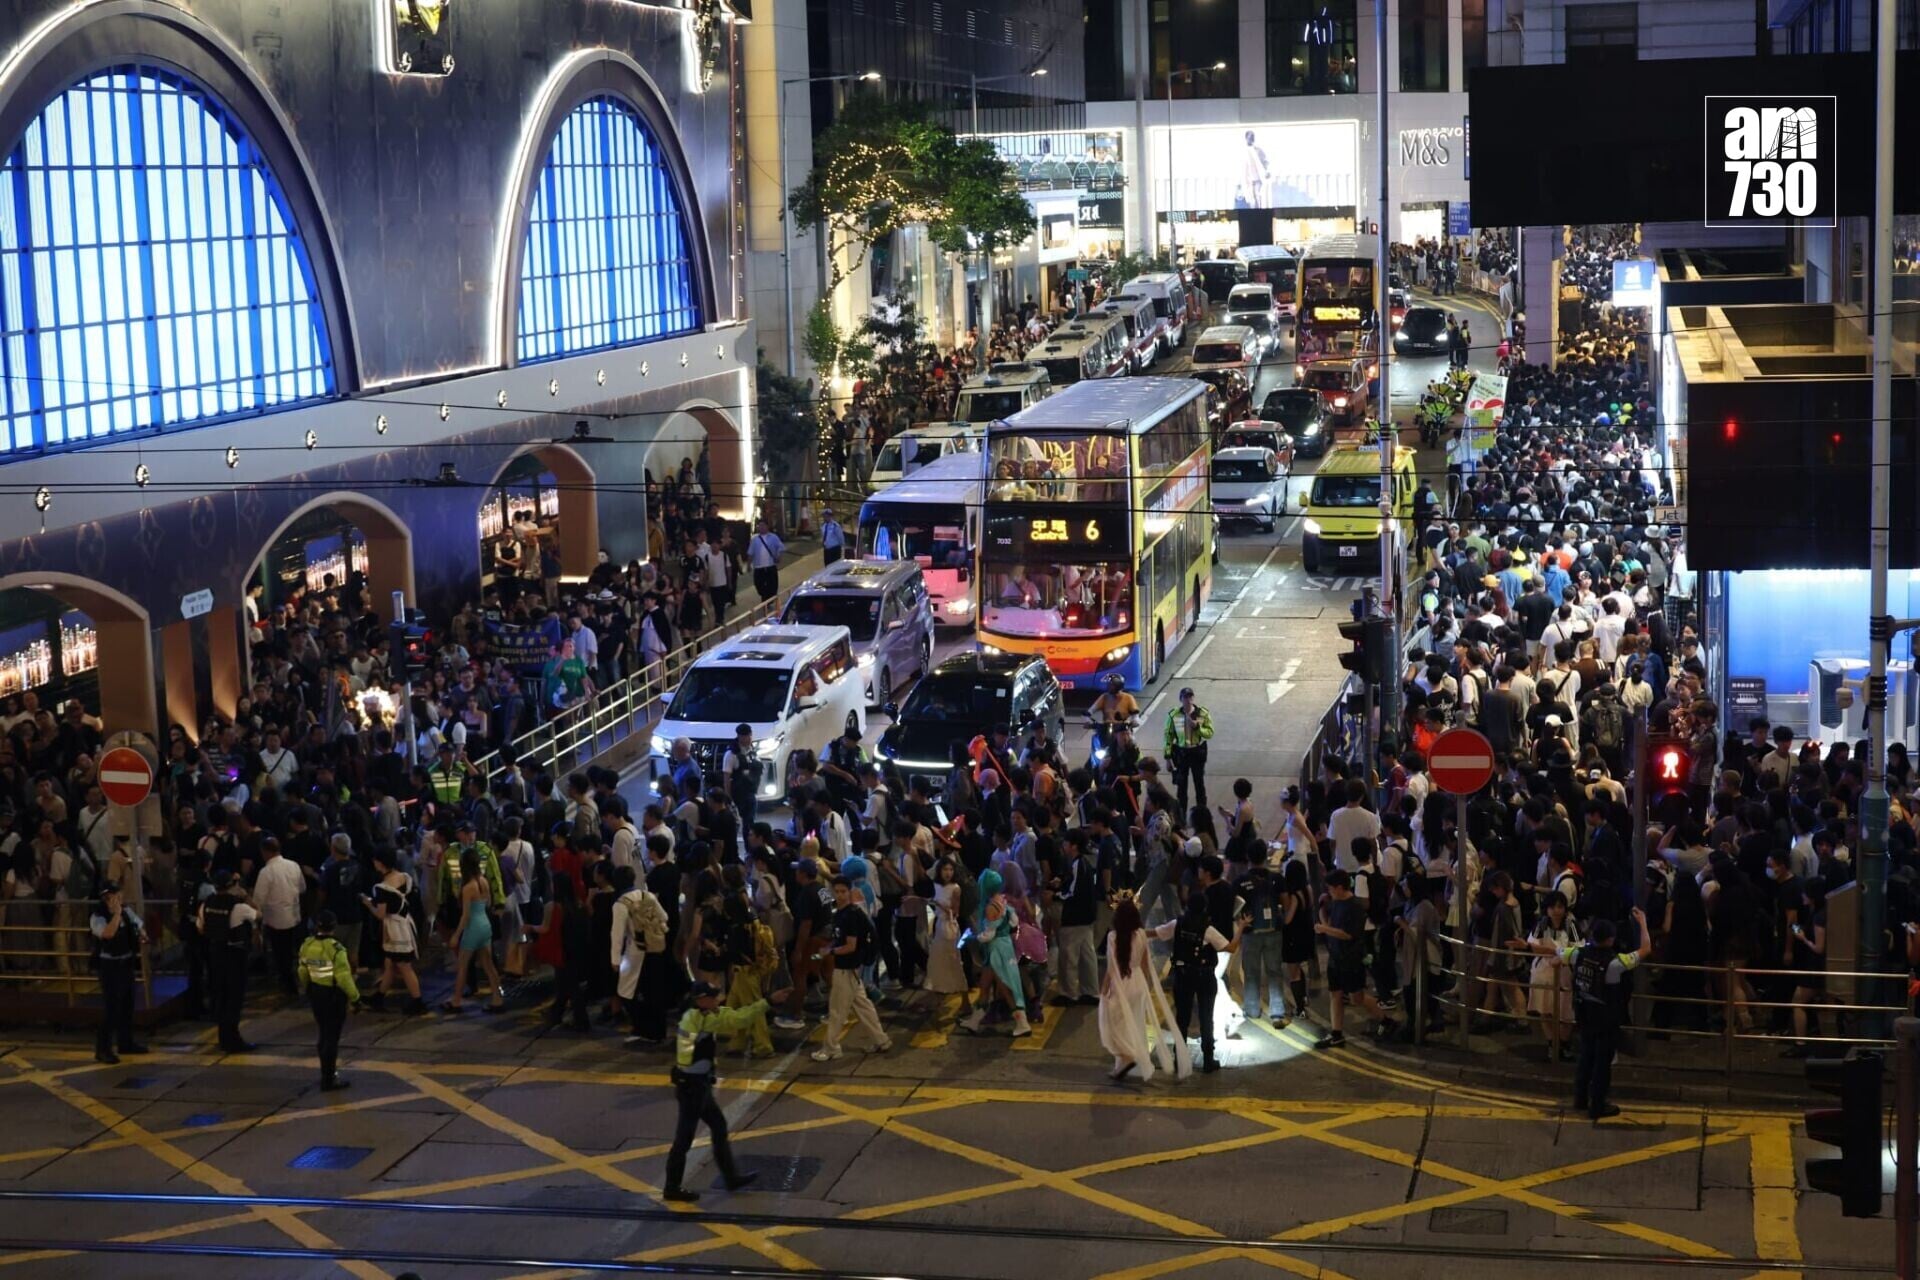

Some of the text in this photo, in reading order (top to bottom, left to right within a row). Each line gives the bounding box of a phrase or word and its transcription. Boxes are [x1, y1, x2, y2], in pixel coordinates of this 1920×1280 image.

[1399, 131, 1450, 166] M&S
[996, 537, 1012, 545] 7032
[1085, 519, 1100, 541] 6
